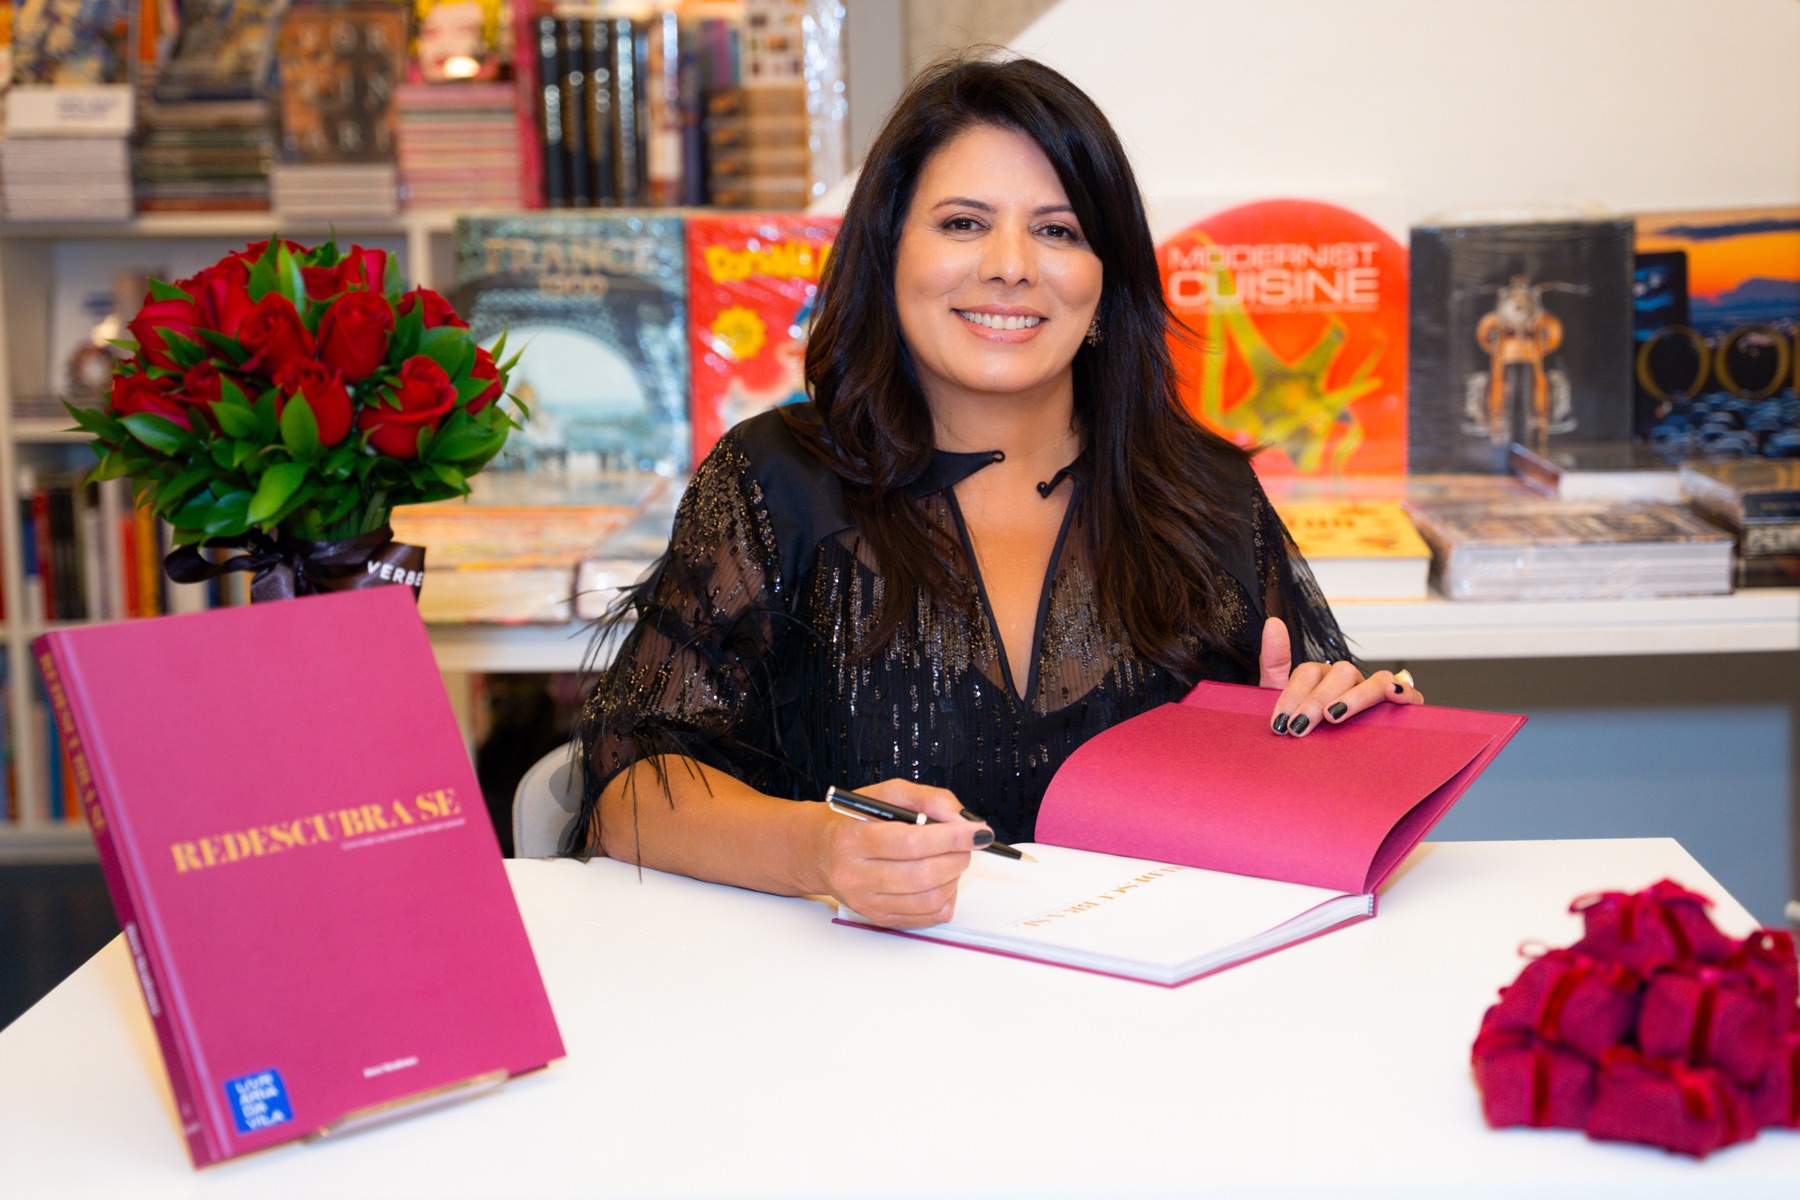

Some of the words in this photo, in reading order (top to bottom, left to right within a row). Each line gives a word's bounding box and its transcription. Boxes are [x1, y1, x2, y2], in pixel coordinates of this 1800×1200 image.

[1167, 242, 1379, 271] MODERNIST
[1168, 267, 1380, 307] CUISINE
[170, 800, 415, 873] REDESCUBRA
[415, 787, 461, 820] SE
